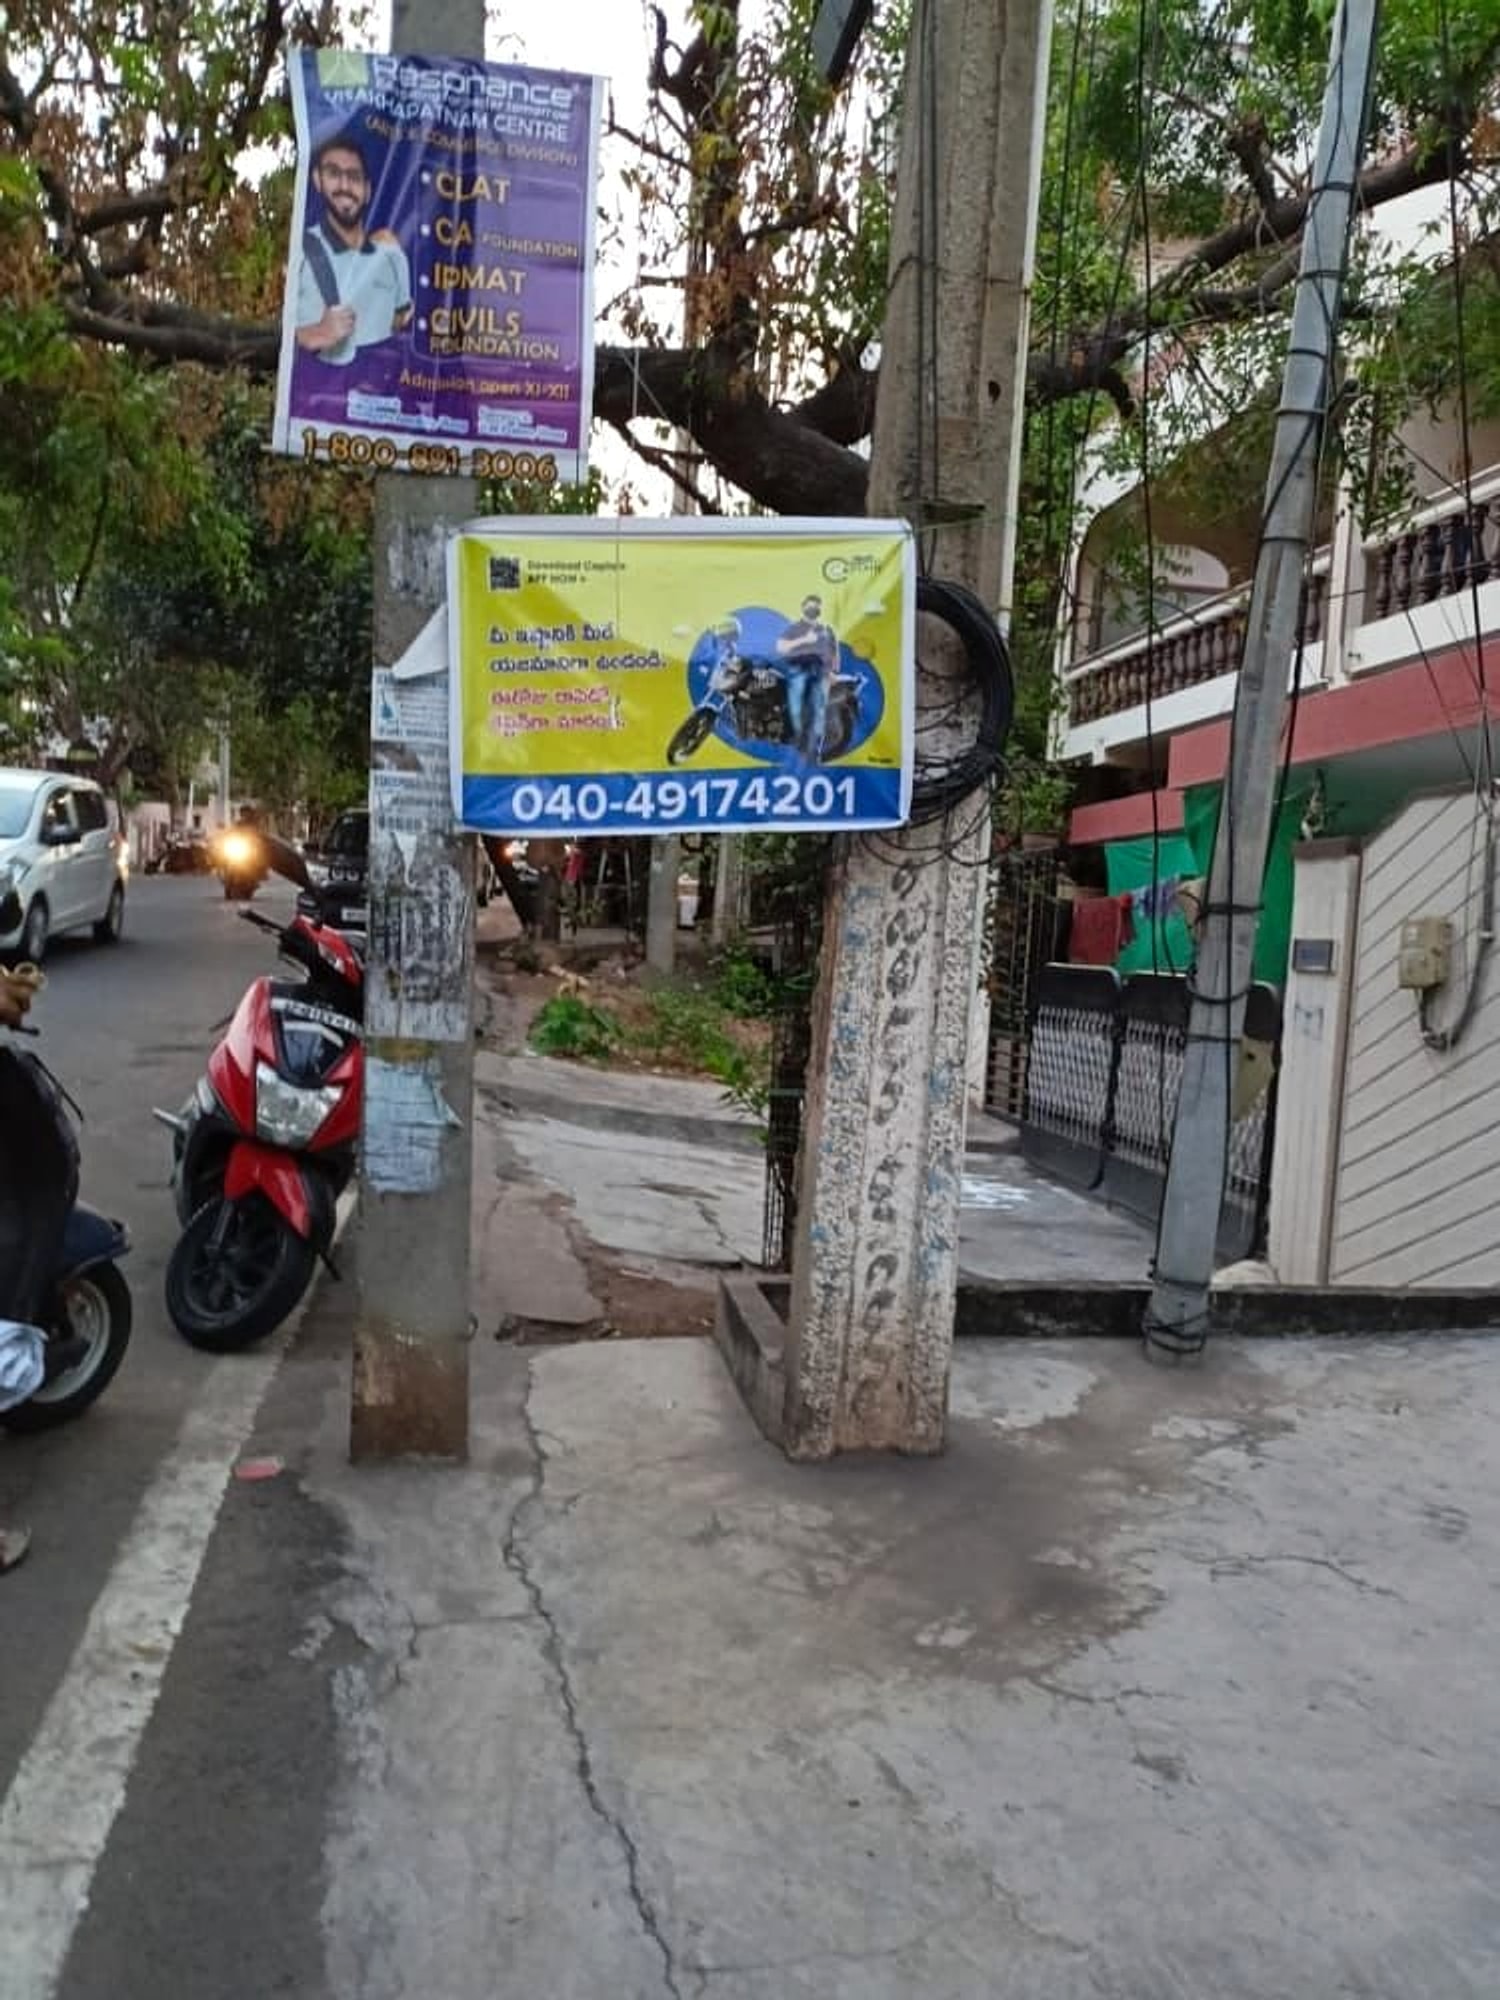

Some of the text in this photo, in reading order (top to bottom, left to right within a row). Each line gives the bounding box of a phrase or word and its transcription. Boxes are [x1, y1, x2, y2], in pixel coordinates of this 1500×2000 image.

[372, 55, 573, 108] Resonance
[494, 113, 569, 142] CENTRE
[435, 170, 510, 204] CLAT
[435, 216, 578, 258] CA FOUNDATION
[433, 263, 526, 294] IPMAT
[430, 307, 520, 338] CIVILS
[429, 335, 559, 360] FOUNDATION
[480, 381, 522, 397] open
[511, 776, 855, 821] 040-49174201
